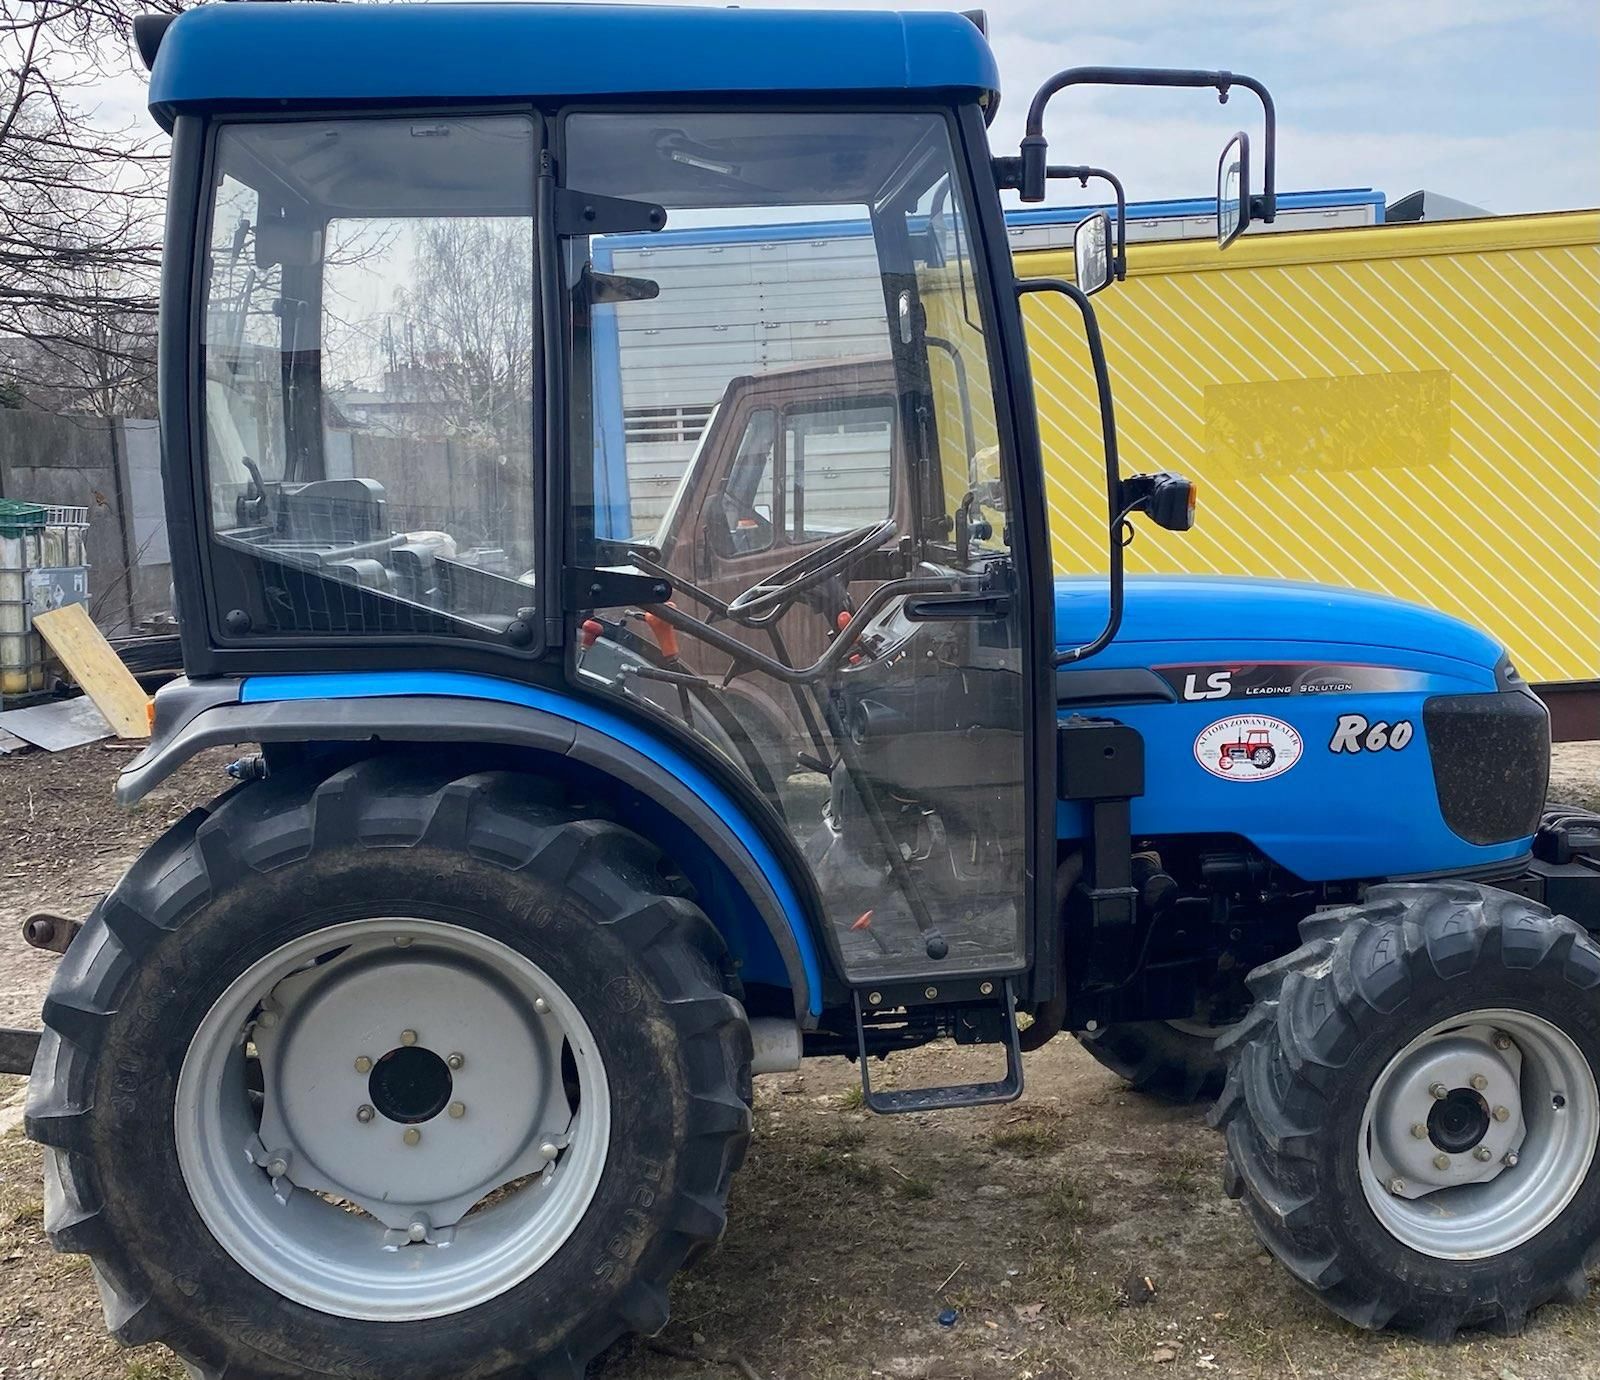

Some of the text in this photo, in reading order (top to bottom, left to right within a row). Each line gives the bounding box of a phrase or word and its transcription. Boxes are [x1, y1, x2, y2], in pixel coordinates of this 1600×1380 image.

[1184, 671, 1232, 700] LS
[1246, 683, 1351, 695] LEADING SOLUTION
[1269, 721, 1299, 746] DEALER
[1329, 714, 1414, 755] R60
